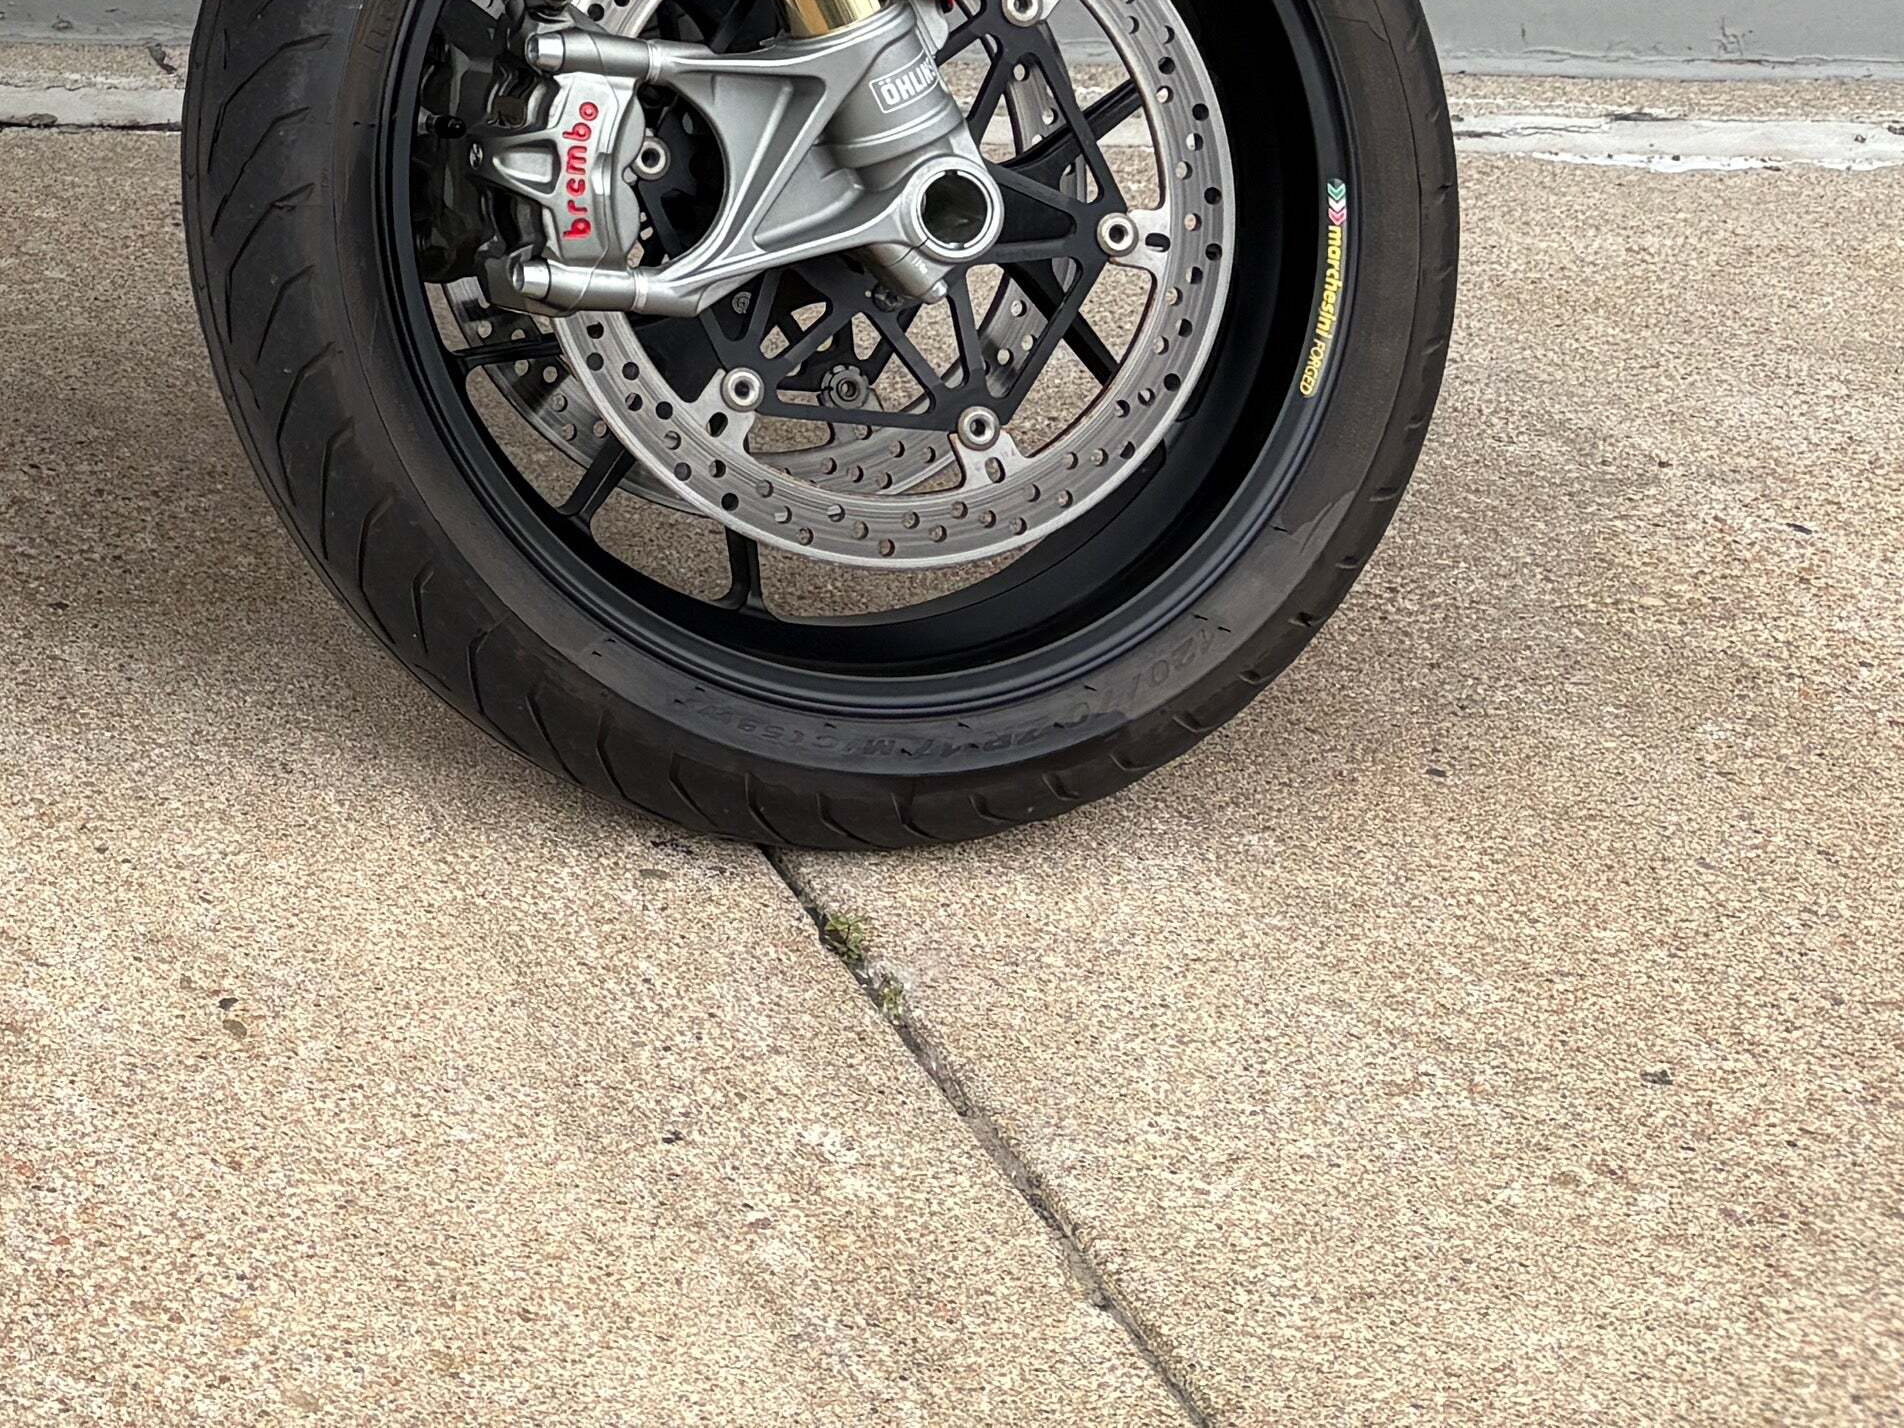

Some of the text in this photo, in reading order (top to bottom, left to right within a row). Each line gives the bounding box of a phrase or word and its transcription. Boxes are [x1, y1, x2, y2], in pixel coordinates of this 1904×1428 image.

[563, 101, 599, 240] brembo
[1300, 225, 1343, 396] marchesini FORGED
